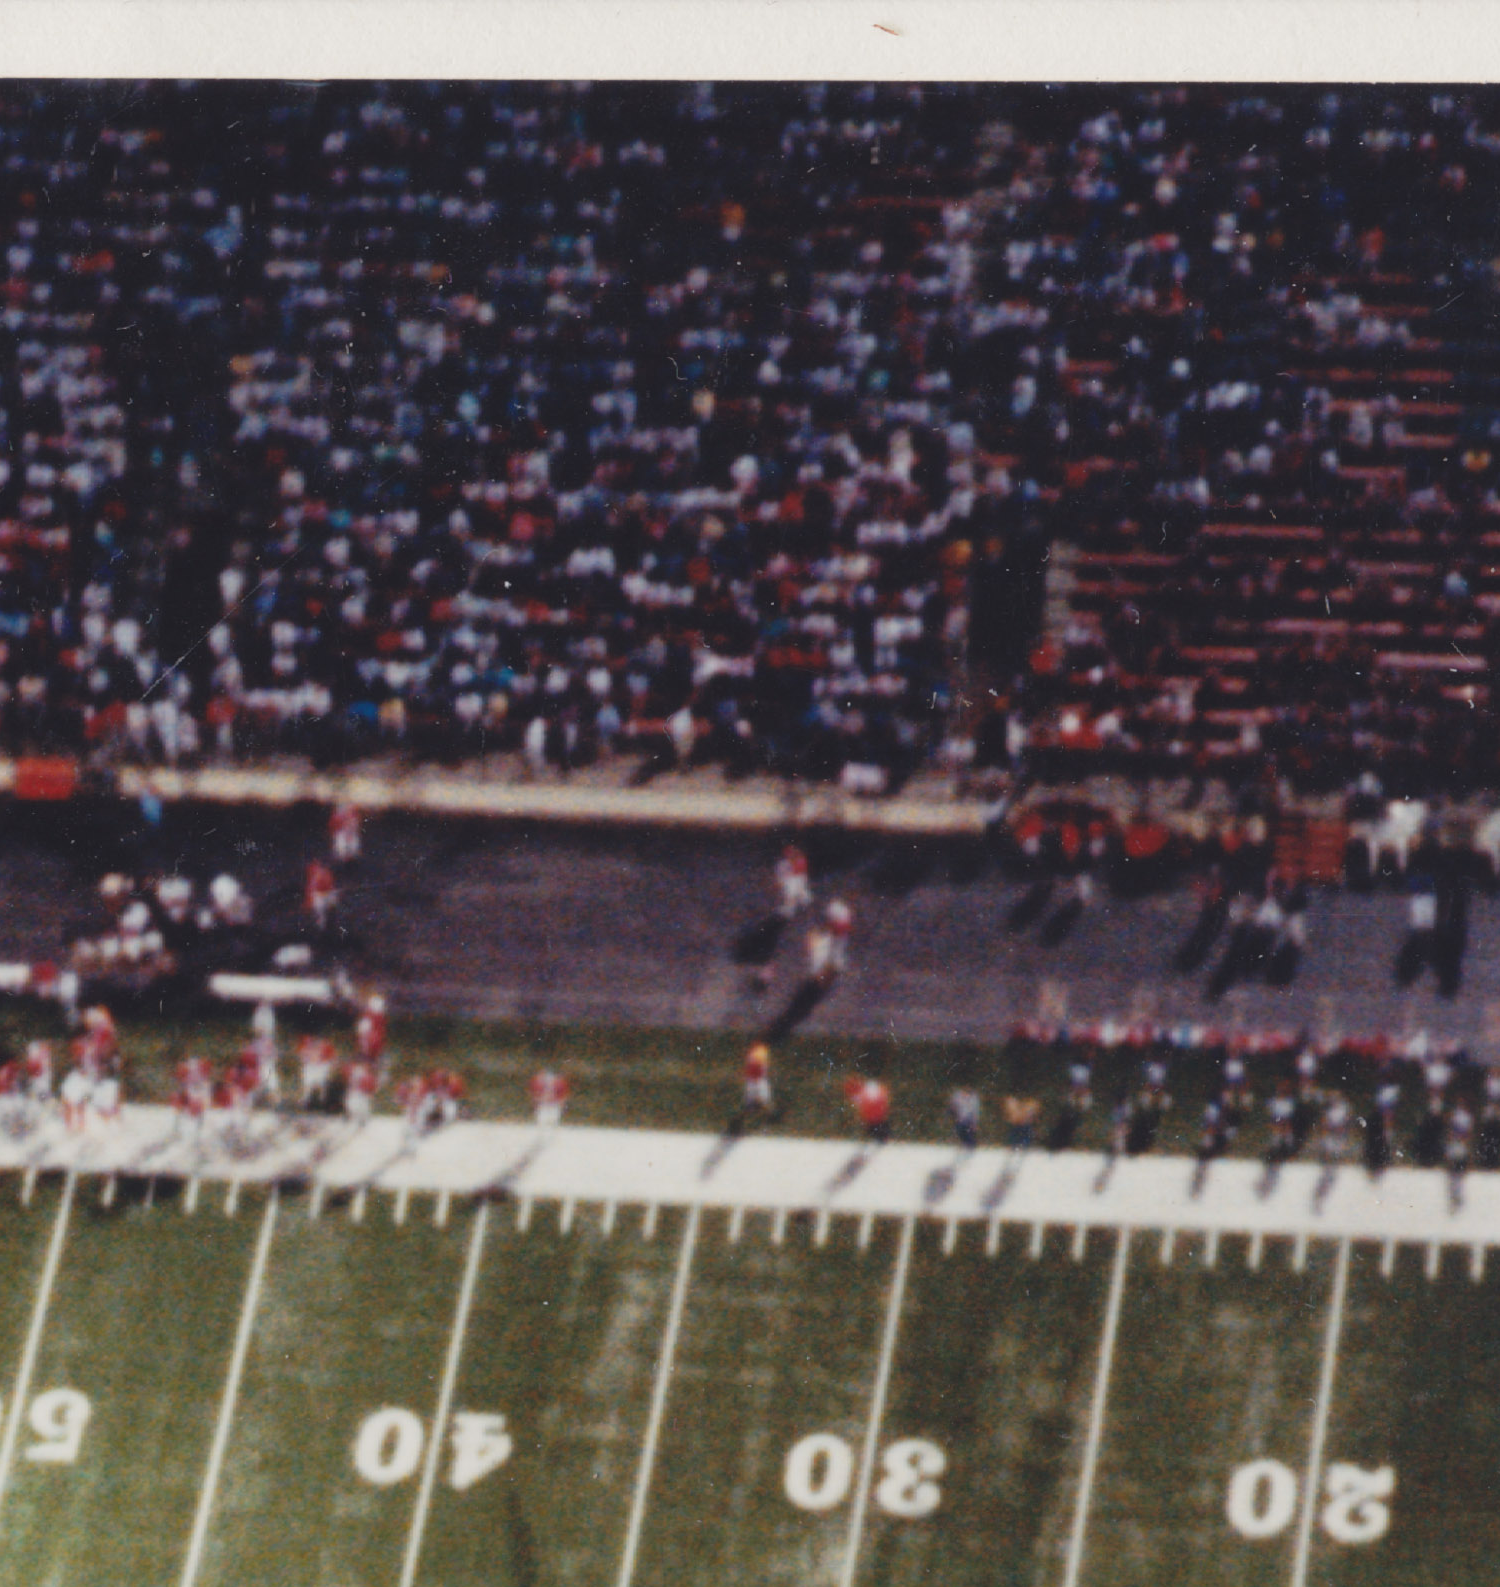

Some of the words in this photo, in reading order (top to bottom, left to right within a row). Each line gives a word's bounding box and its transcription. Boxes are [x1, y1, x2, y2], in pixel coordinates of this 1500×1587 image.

[352, 1404, 512, 1490] 40
[782, 1430, 947, 1518] 30
[1225, 1456, 1396, 1544] 20
